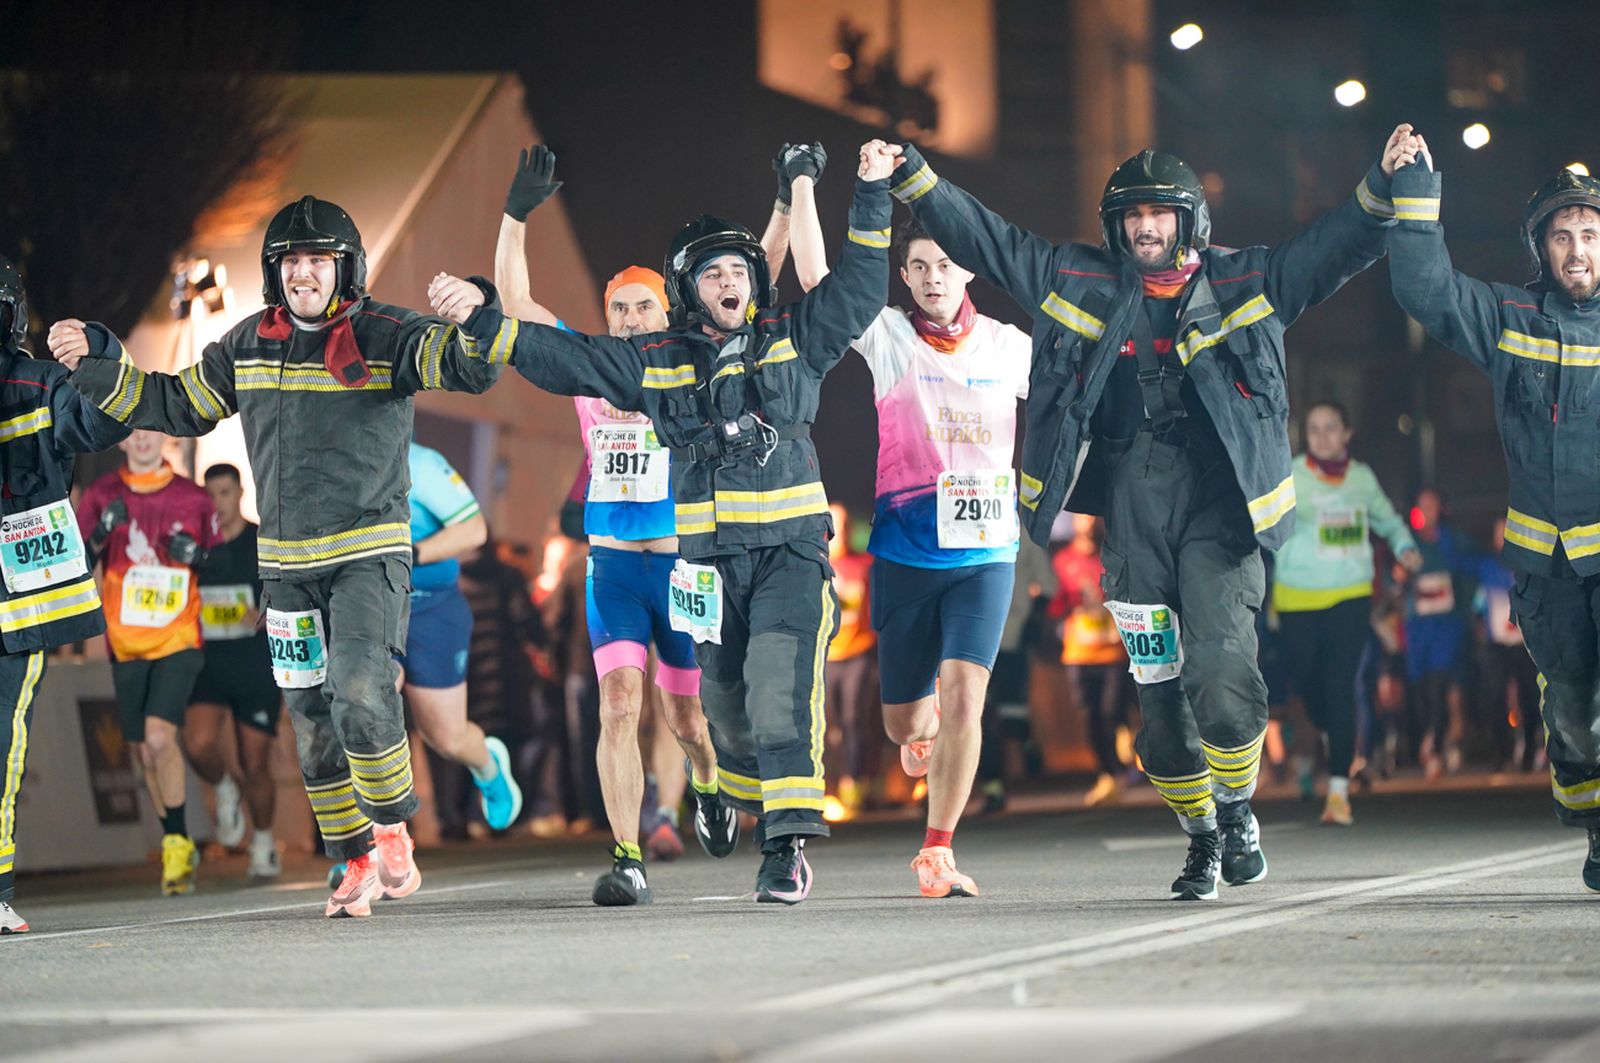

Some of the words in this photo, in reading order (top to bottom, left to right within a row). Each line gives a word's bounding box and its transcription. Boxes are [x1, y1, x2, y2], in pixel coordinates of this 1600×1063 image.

[938, 406, 982, 424] Finca
[604, 451, 650, 475] 3917
[947, 488, 965, 497] SAN
[954, 497, 1002, 521] 2920
[12, 518, 35, 532] NOCHE
[34, 516, 44, 526] DE
[4, 531, 22, 543] SAN
[14, 530, 68, 565] 9242
[671, 585, 706, 618] 9245
[1134, 613, 1144, 622] DE
